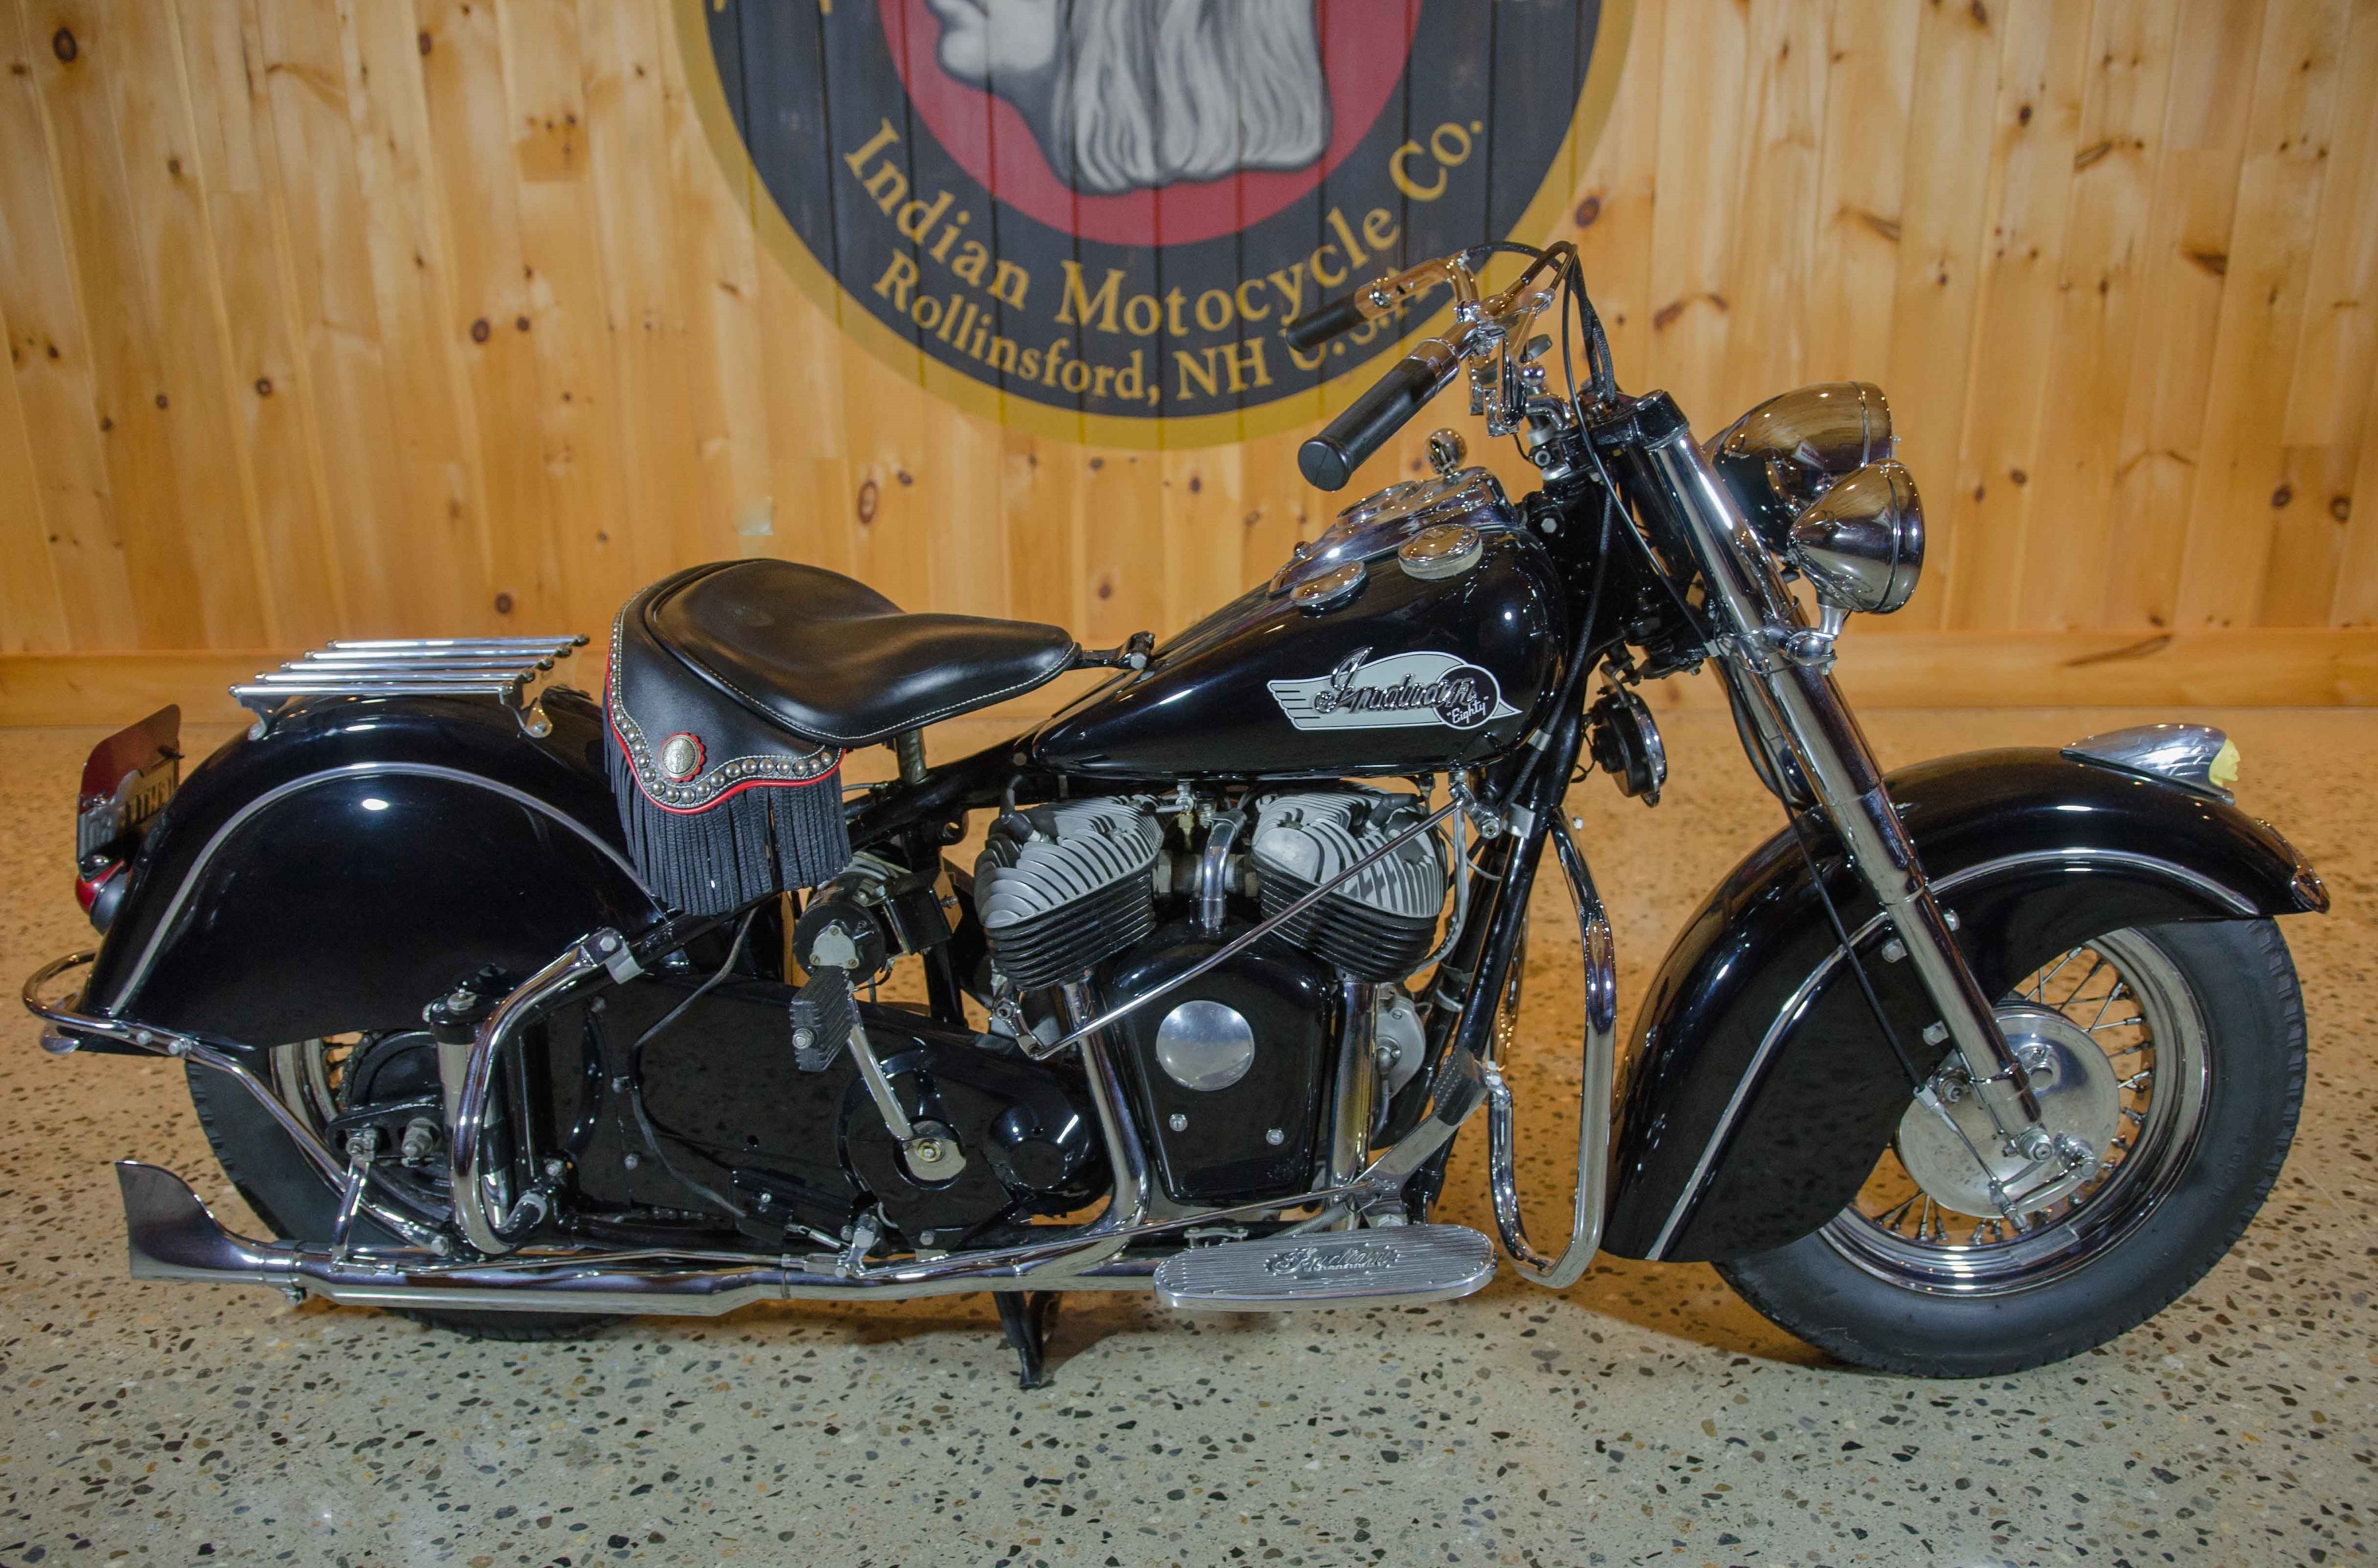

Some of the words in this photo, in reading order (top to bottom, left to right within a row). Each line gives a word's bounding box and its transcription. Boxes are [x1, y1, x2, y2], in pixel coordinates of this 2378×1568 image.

[844, 117, 1029, 310] Indian
[1054, 207, 1400, 337] Motocycle
[1389, 120, 1483, 201] Co.
[872, 249, 1160, 407] Rollinsford,
[1173, 337, 1273, 400] NH
[1314, 646, 1479, 714] Indian
